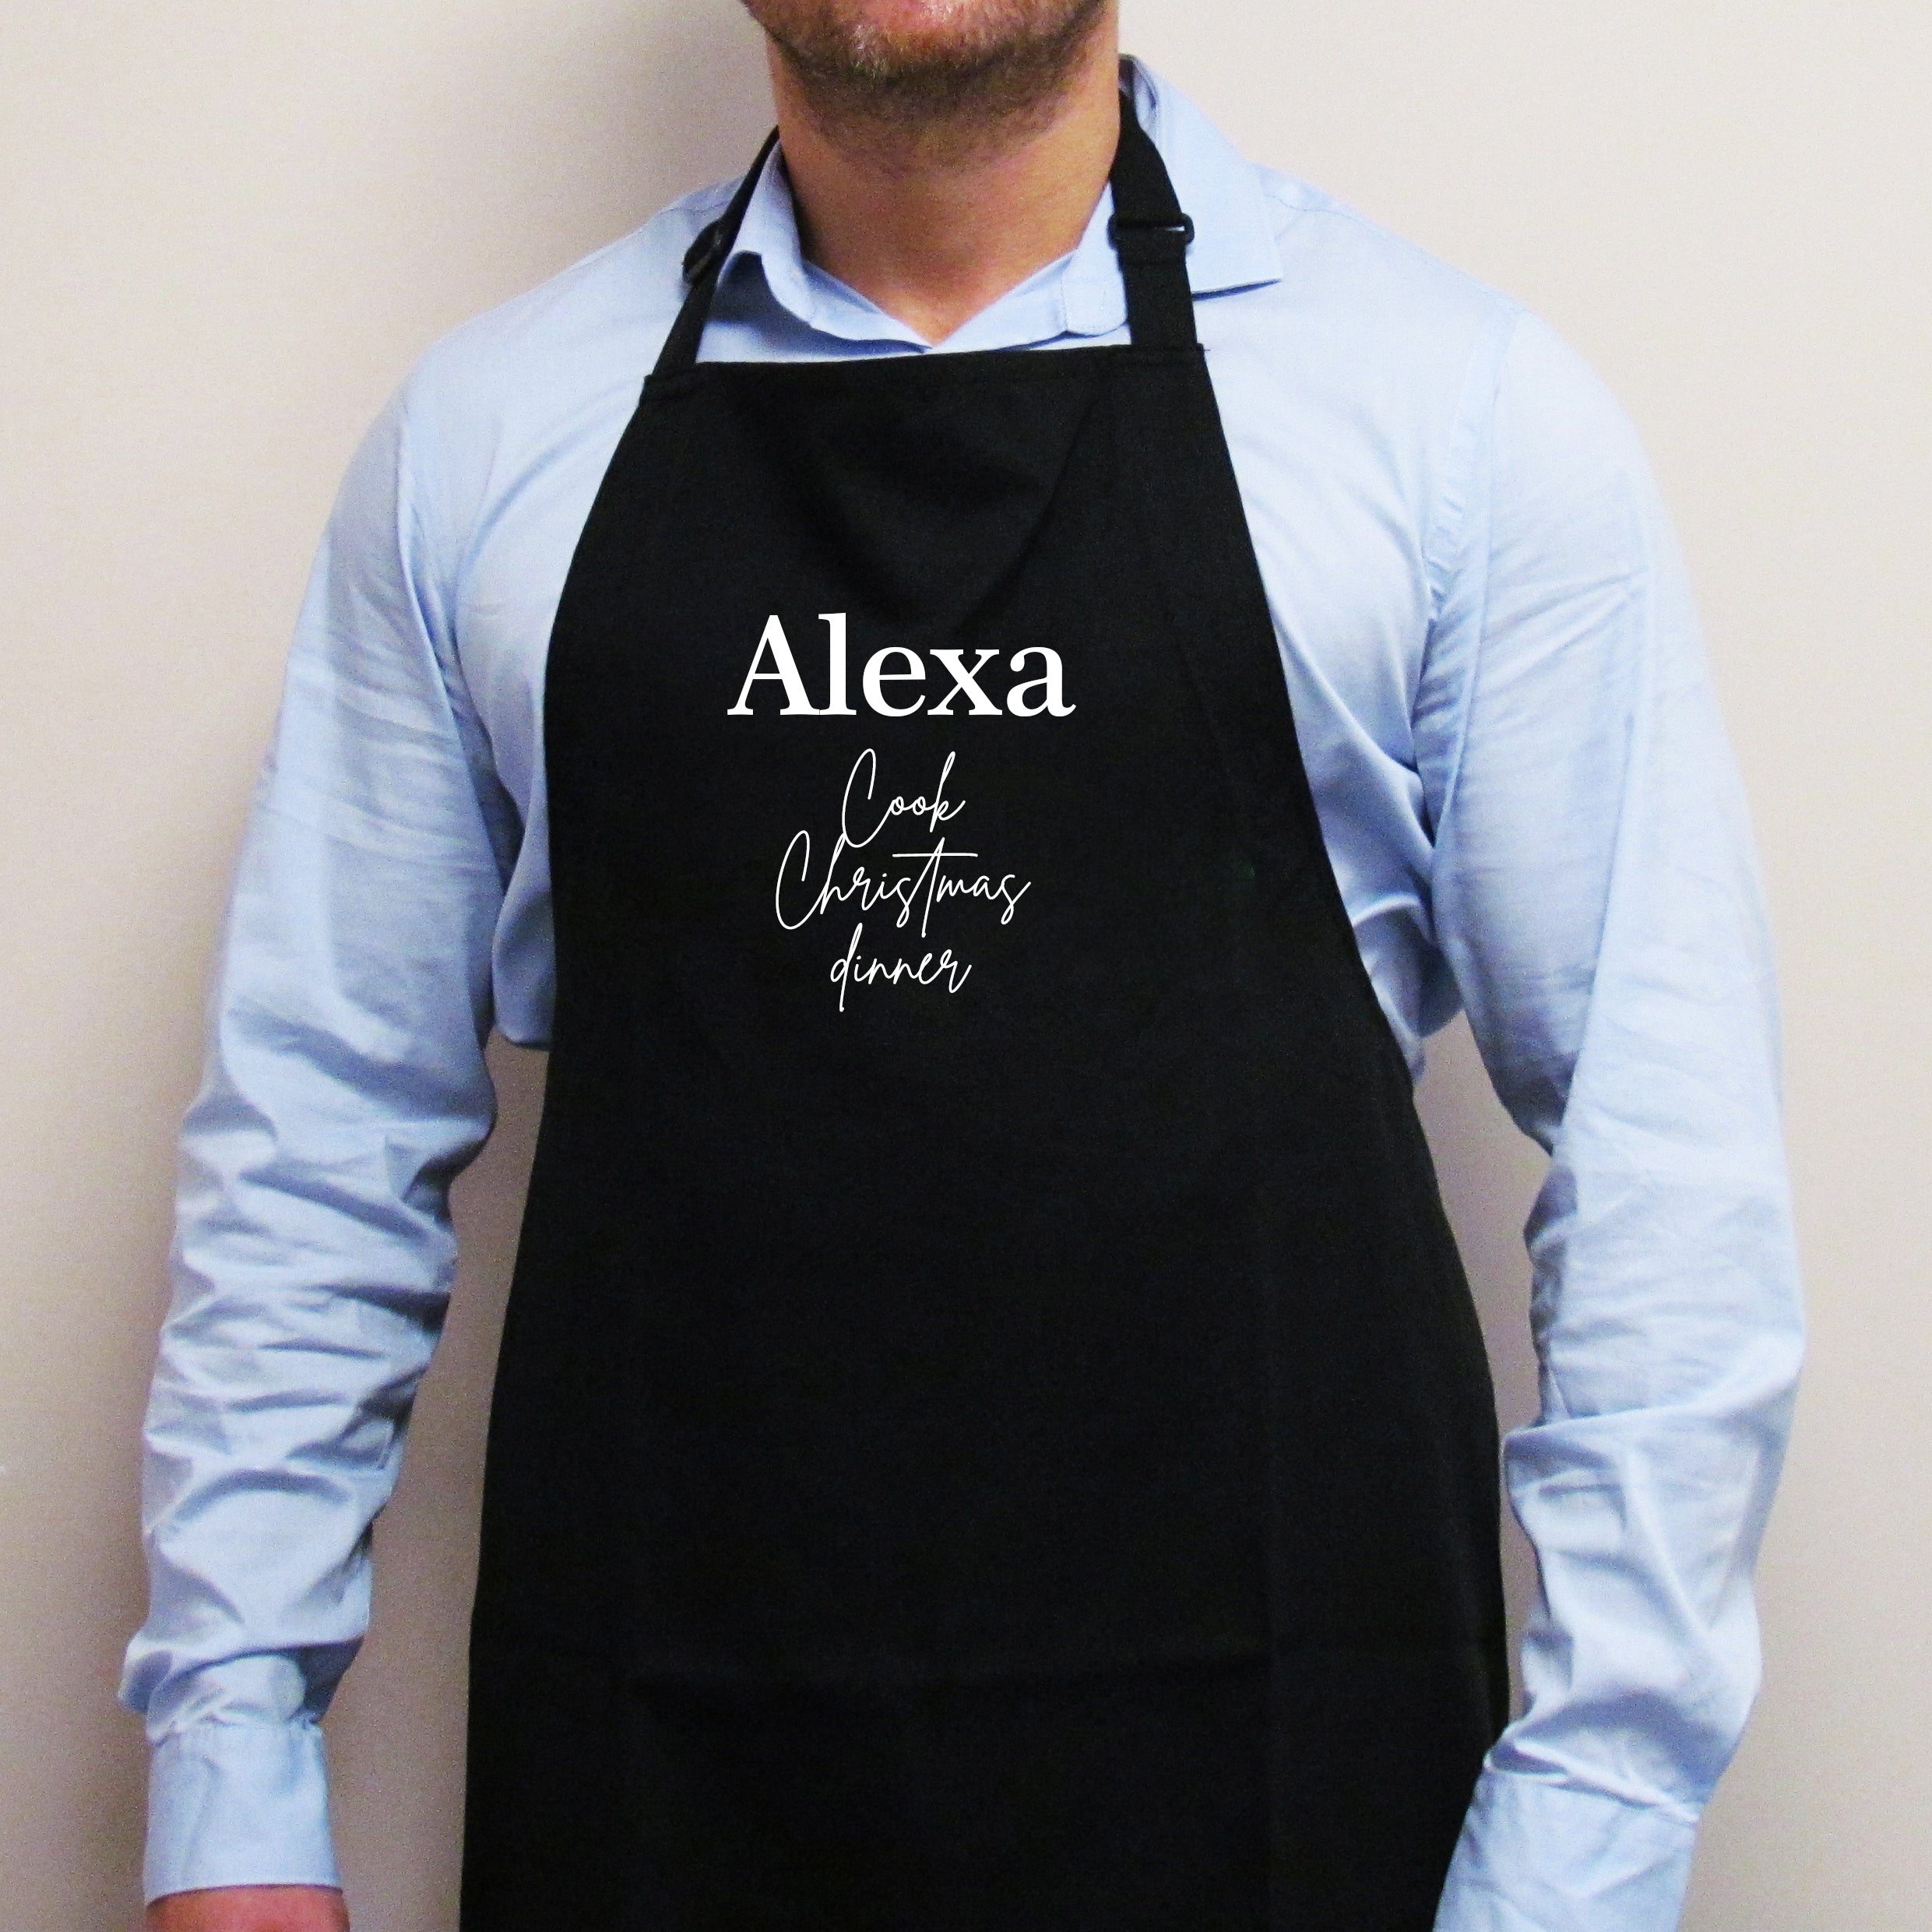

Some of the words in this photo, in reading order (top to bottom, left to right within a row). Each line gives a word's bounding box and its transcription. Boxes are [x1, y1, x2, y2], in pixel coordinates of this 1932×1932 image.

[727, 612, 1077, 717] Alexa
[841, 748, 966, 848] Cook
[775, 829, 1032, 938] Christmas
[829, 922, 973, 1012] dinner
